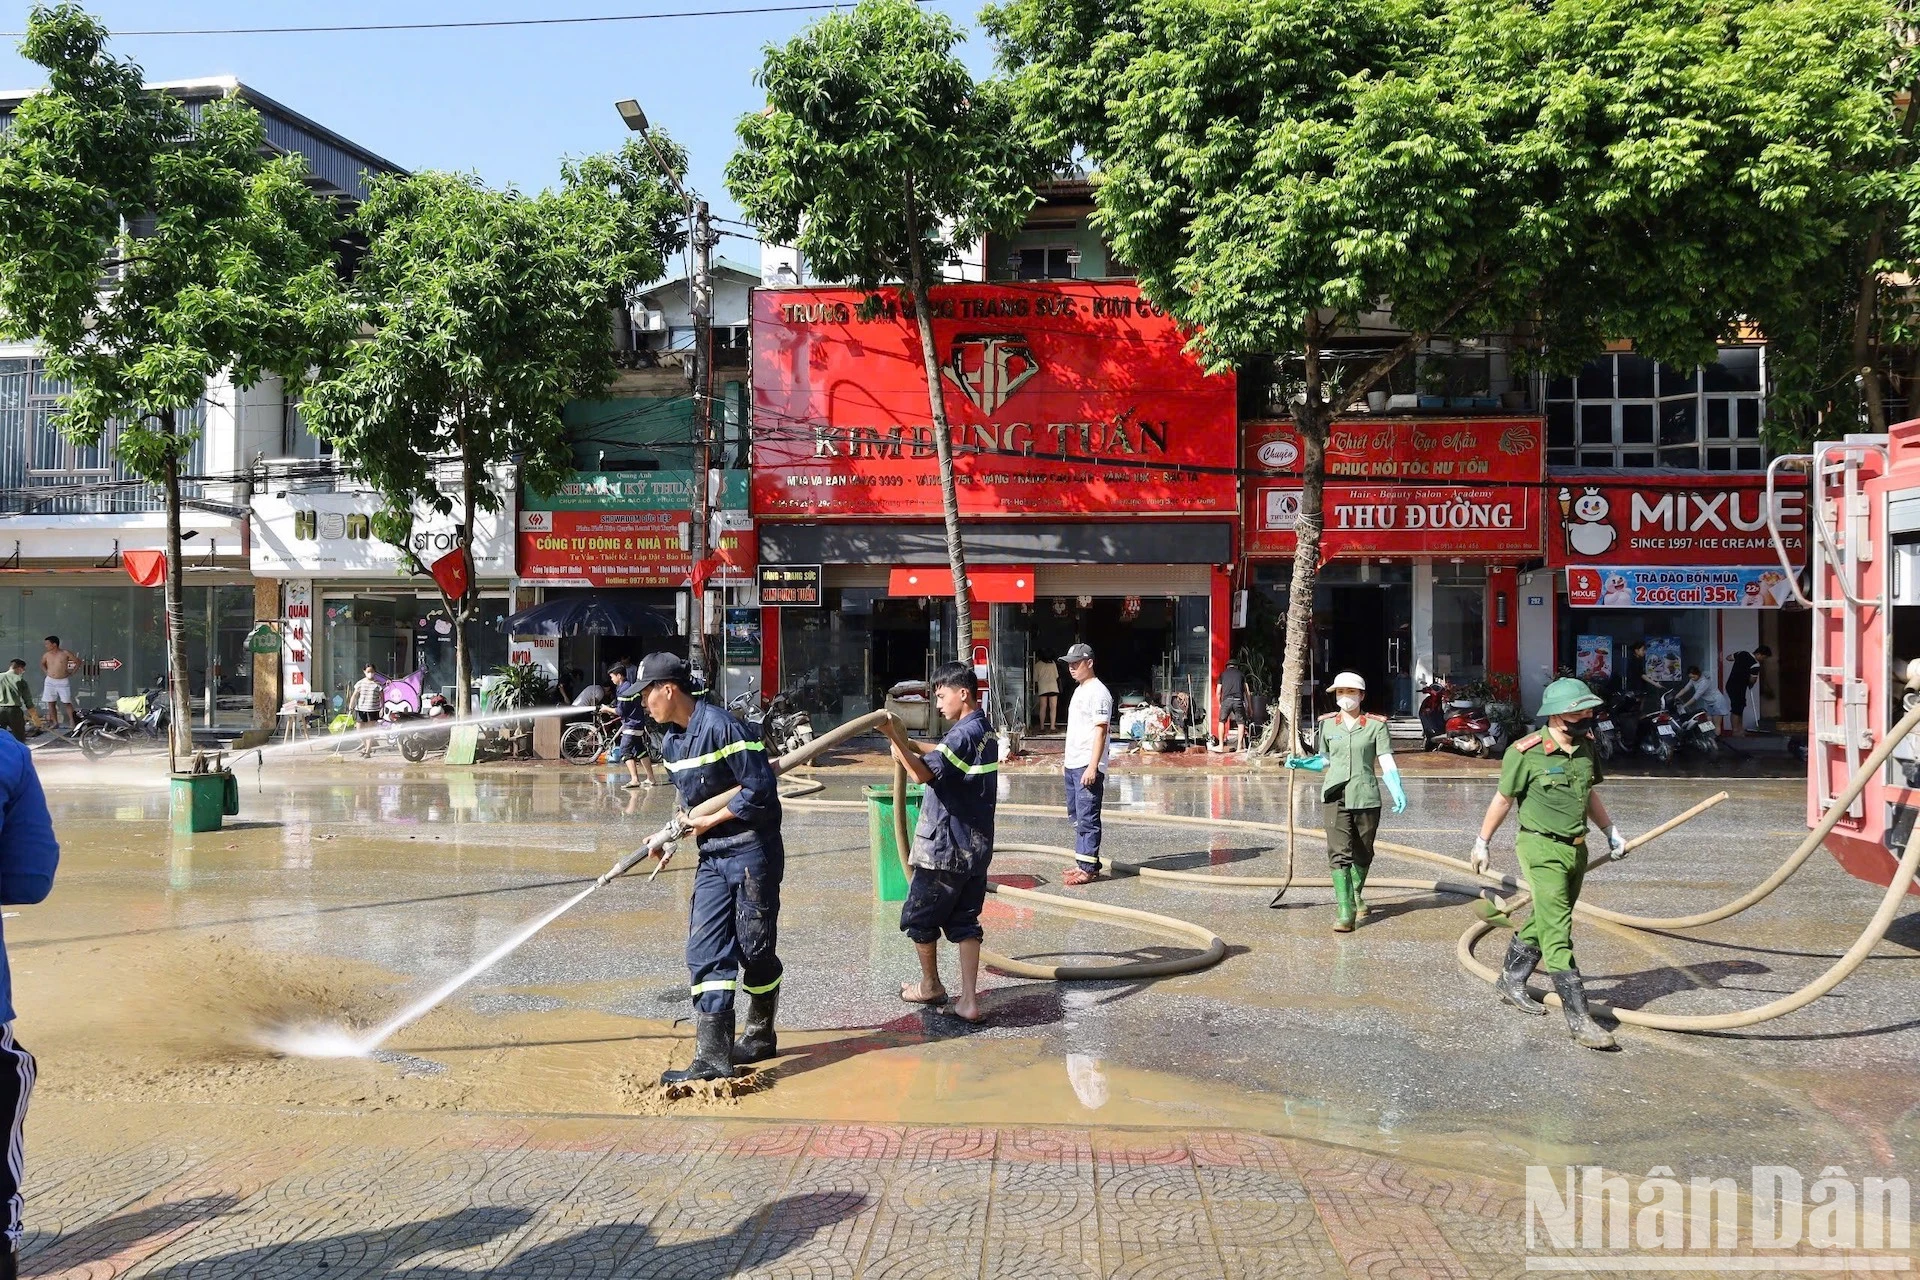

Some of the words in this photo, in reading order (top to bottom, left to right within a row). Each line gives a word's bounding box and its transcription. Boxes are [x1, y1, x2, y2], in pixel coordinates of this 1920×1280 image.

[781, 303, 848, 323] TRUNG
[1093, 296, 1132, 319] KIM
[813, 425, 899, 459] KIM
[1048, 406, 1168, 454] TUẤN
[1263, 446, 1293, 461] Chuyên
[1349, 490, 1371, 499] Hair
[1379, 490, 1412, 501] Beauty
[1415, 490, 1442, 499] Salon
[1450, 489, 1494, 500] Academy
[1334, 504, 1398, 529] THU
[1405, 496, 1513, 529] ĐƯỜNG
[1631, 491, 1804, 532] MIXUE
[601, 515, 640, 523] SHOWROOM
[536, 534, 568, 550] CỔNG
[588, 536, 621, 553] ĐỘNG
[624, 538, 633, 549] &
[637, 535, 661, 549] NHÀ
[1630, 538, 1665, 549] SINCE
[1668, 538, 1693, 549] 1997
[1700, 538, 1719, 549] ICE
[1722, 538, 1765, 549] CREAM
[605, 577, 629, 585] Hotline:
[763, 569, 779, 581] VÀNG
[784, 571, 803, 581] TRANG
[1635, 571, 1657, 583] TRÀ
[763, 588, 777, 602] KIM
